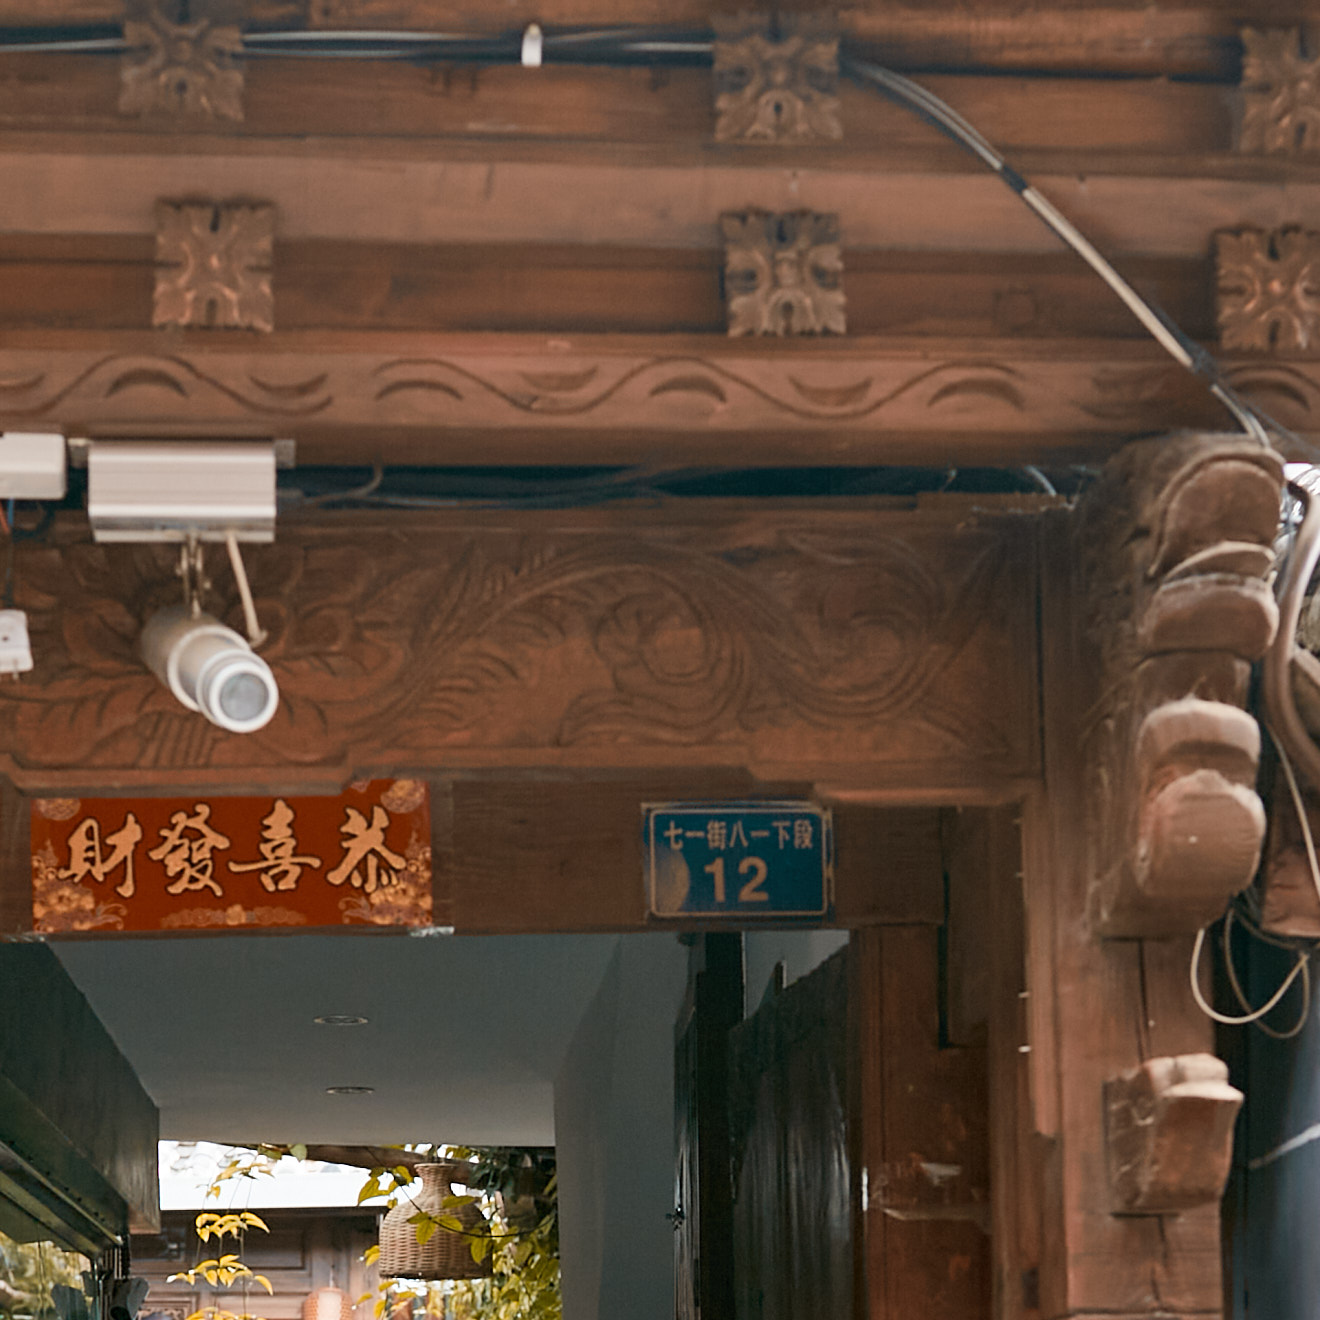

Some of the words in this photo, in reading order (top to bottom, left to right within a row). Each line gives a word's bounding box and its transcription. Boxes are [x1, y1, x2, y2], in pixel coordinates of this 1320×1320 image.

[663, 819, 814, 851] 七一街八一下段
[703, 855, 770, 903] 12
